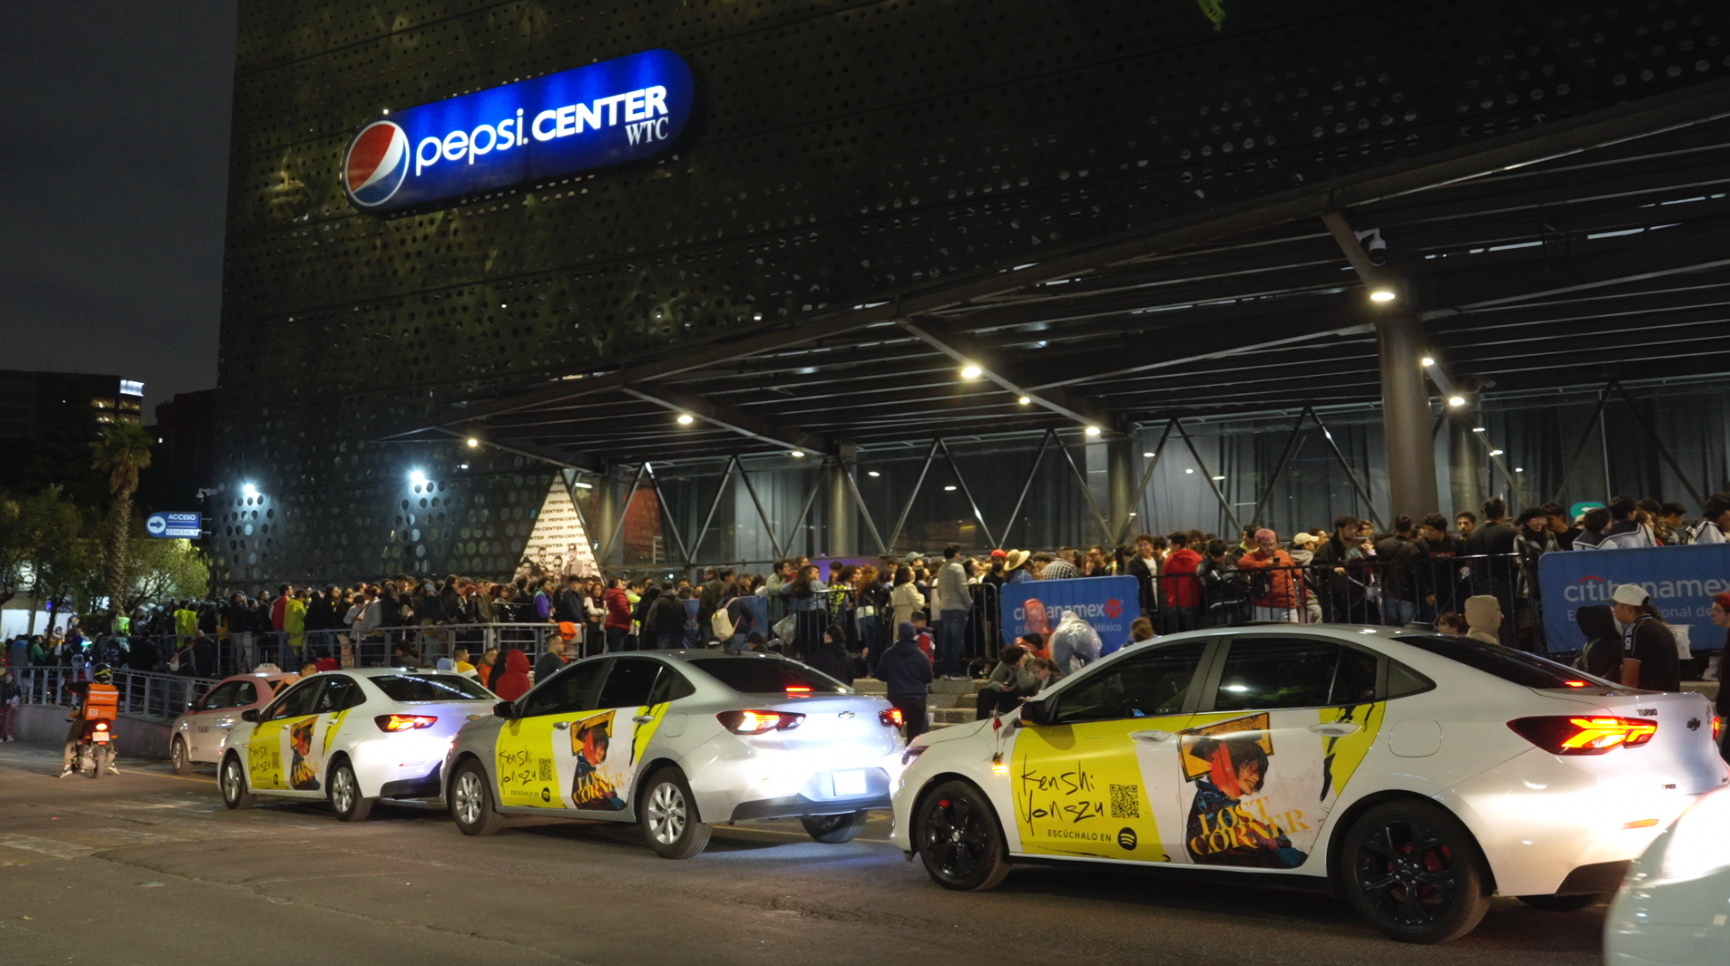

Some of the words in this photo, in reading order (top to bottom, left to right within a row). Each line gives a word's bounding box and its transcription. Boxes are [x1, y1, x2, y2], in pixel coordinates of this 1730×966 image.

[531, 85, 667, 141] CENTER
[625, 116, 669, 146] WTC
[1636, 708, 1658, 717] TURBO
[572, 772, 626, 804] CORNER
[1020, 753, 1096, 796] Kenshi
[1190, 809, 1311, 856] CORNER
[1198, 796, 1271, 836] LOST
[1047, 829, 1098, 841] ESCÚCHALO
[1100, 833, 1112, 842] EN
